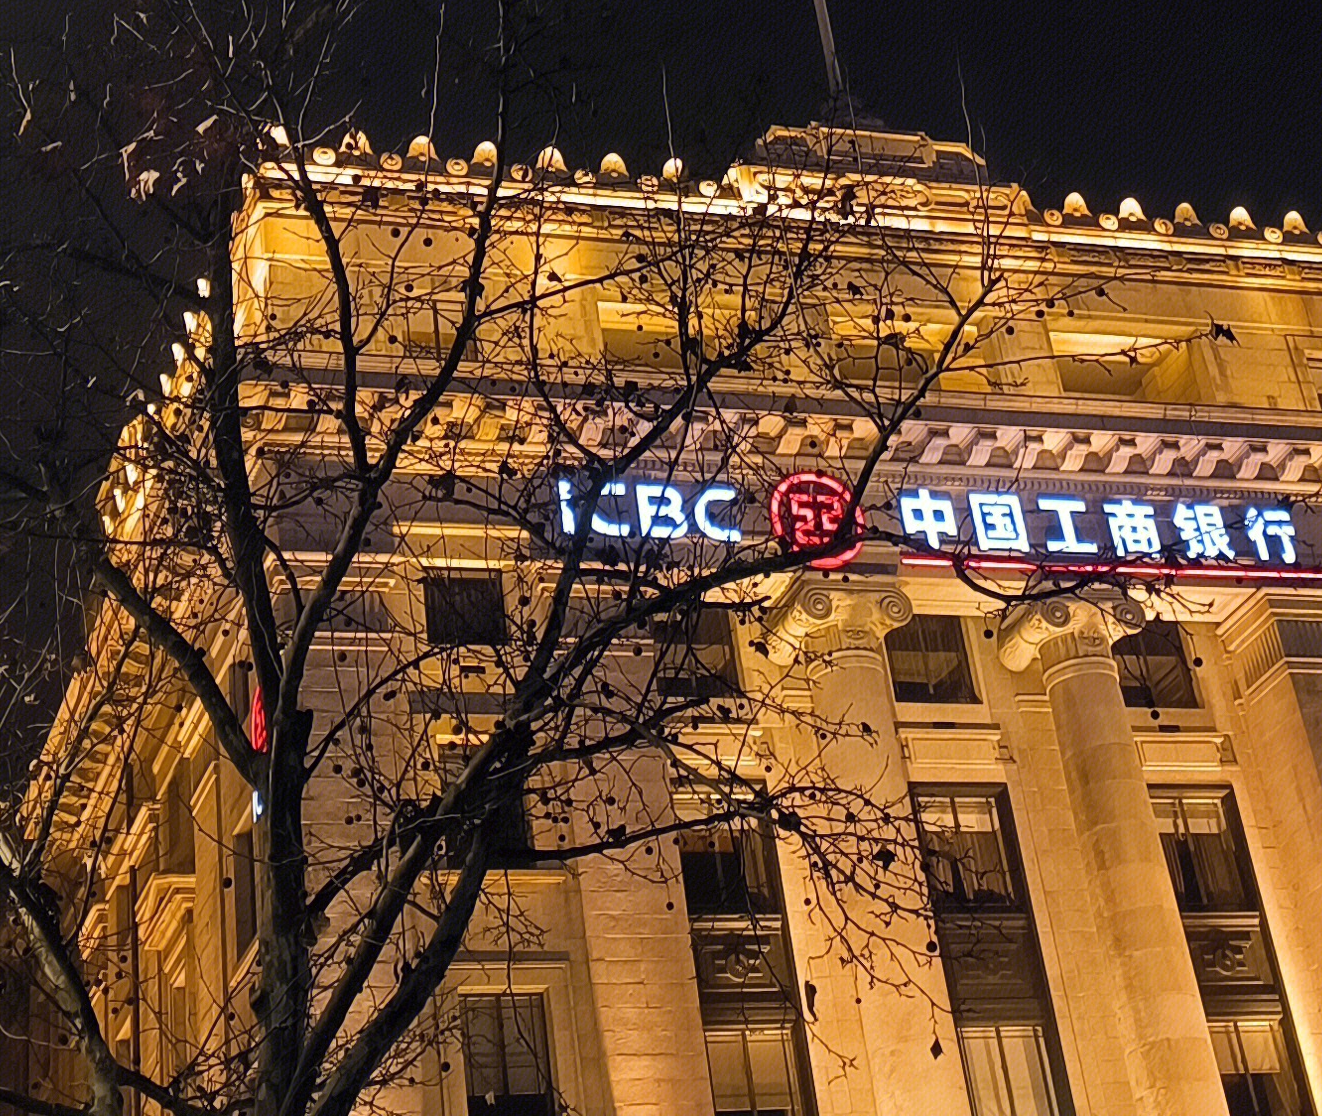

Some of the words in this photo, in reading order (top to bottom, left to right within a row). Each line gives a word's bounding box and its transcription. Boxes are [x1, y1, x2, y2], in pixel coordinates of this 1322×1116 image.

[900, 488, 1297, 564] 中国工商银行
